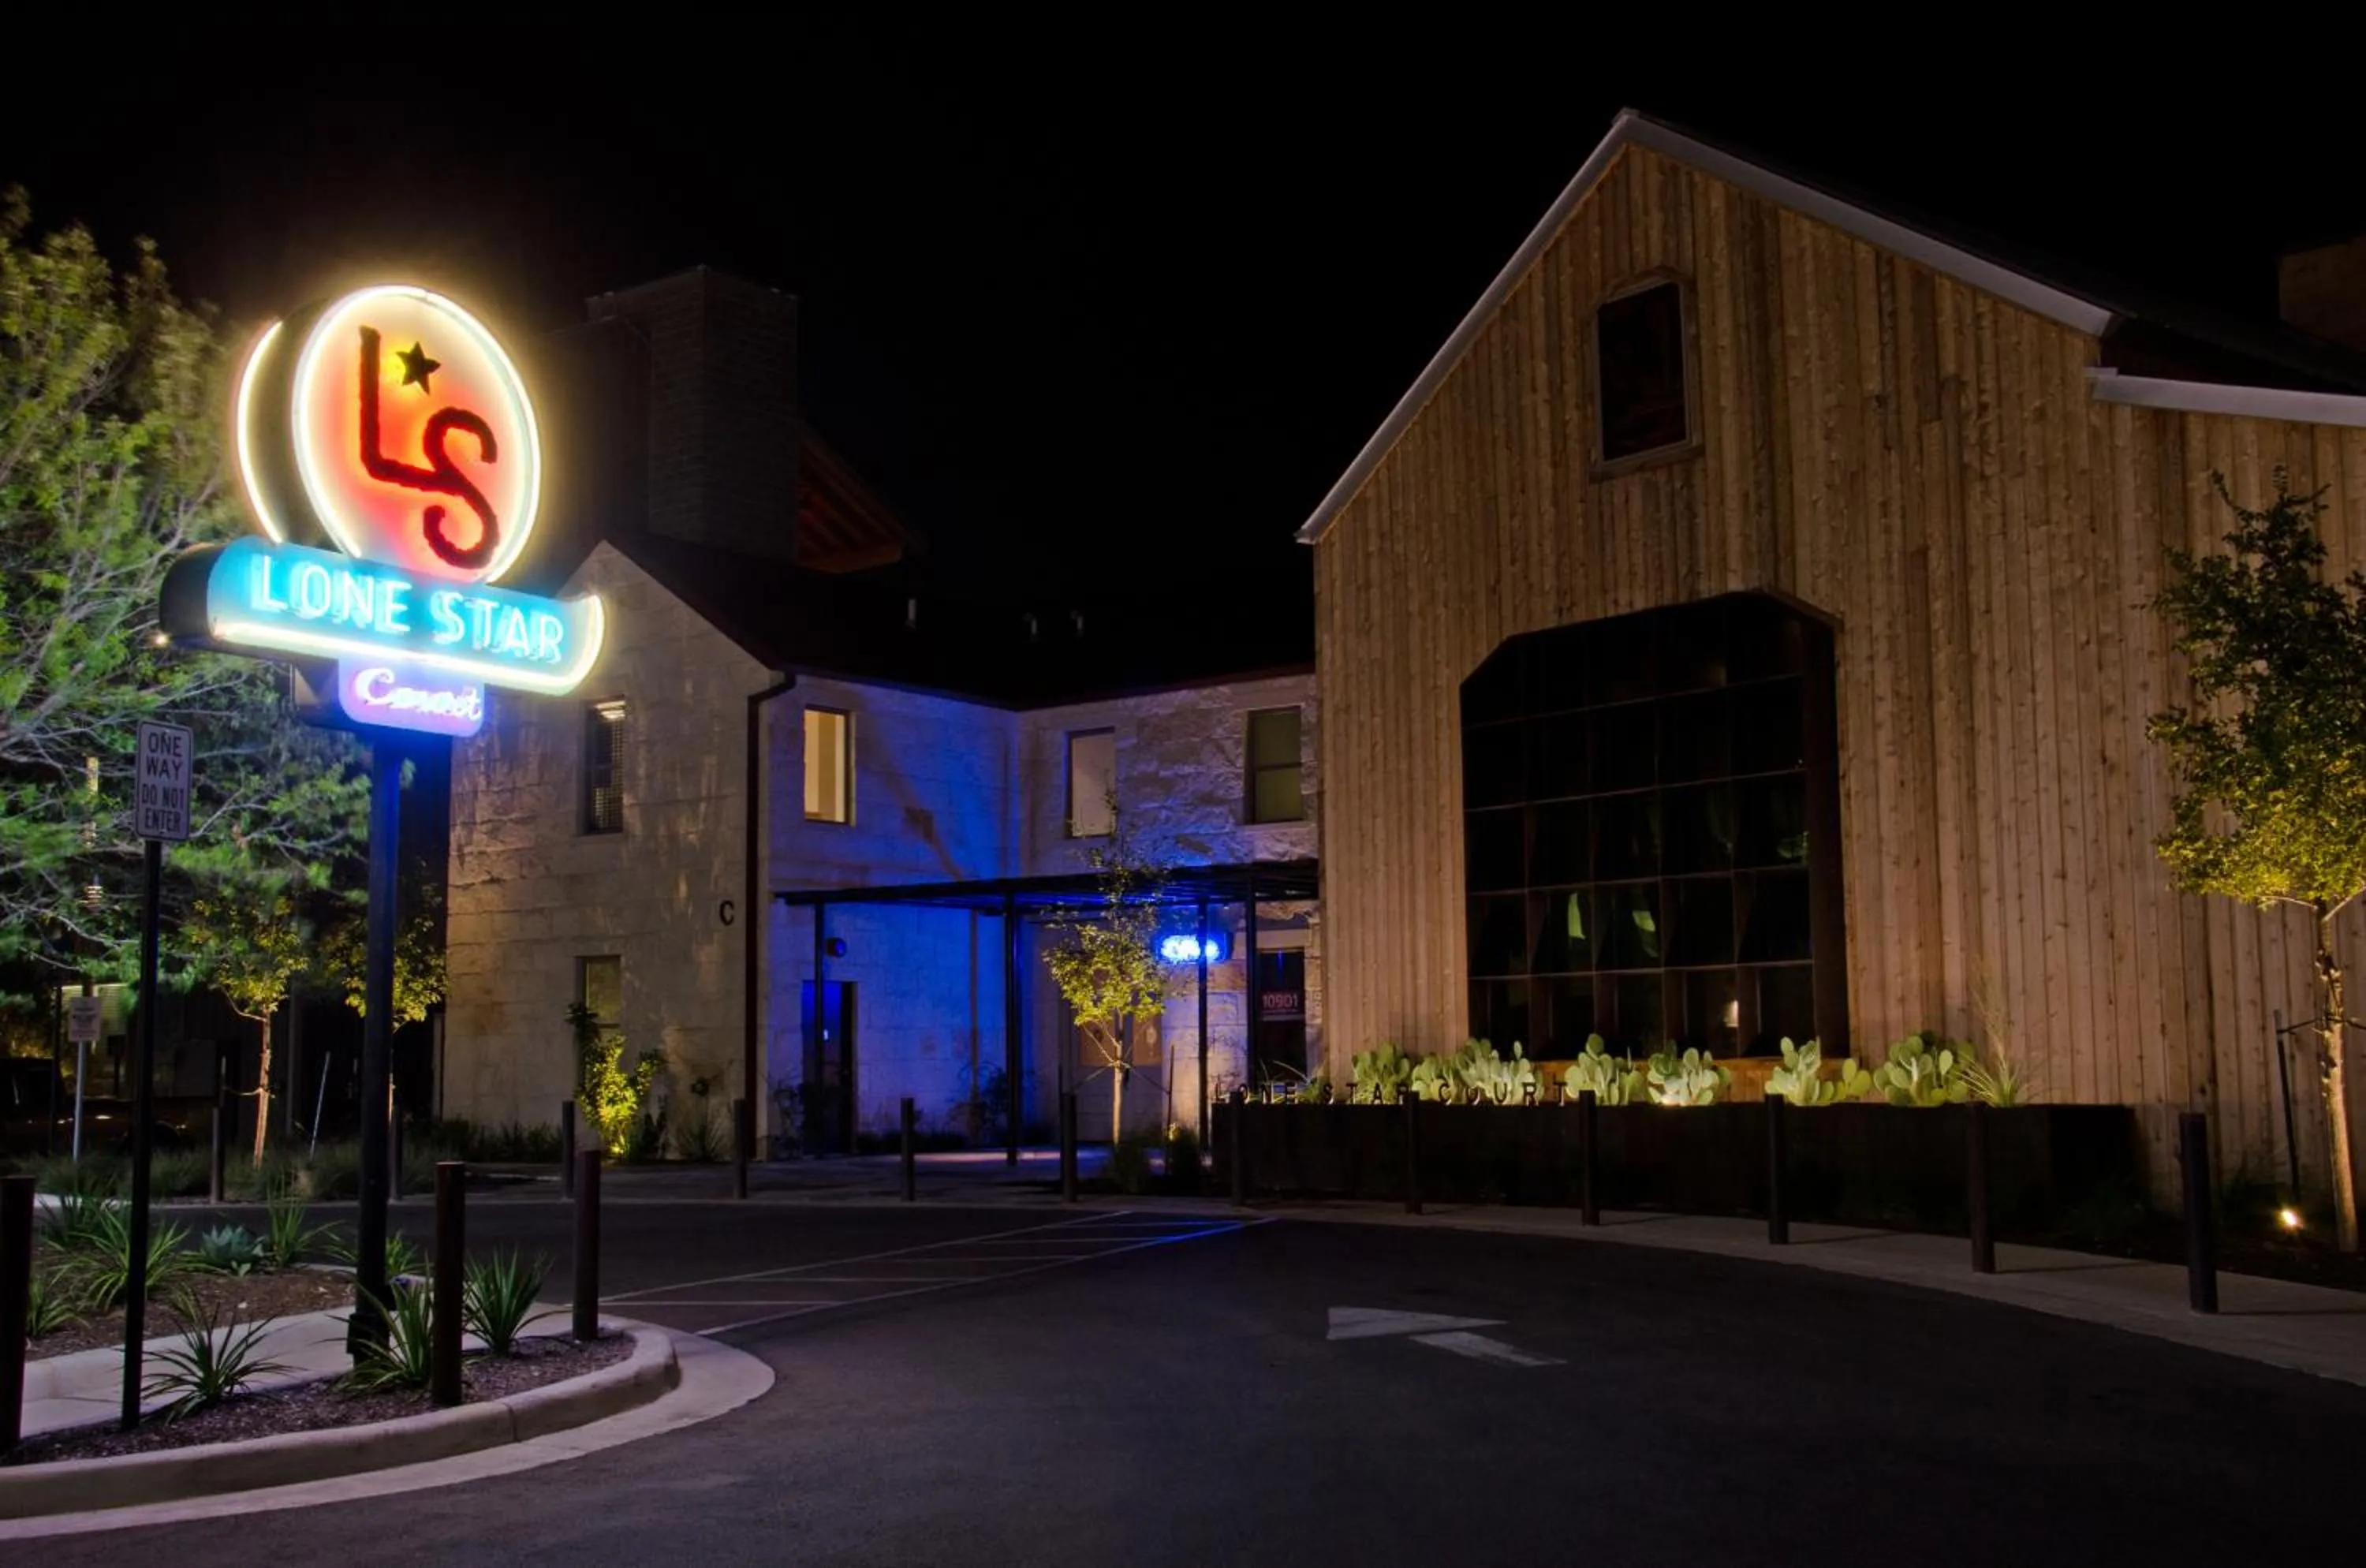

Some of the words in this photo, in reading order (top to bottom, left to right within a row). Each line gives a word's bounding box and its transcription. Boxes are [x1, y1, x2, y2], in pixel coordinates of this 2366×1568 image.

[252, 553, 412, 635] LONE
[430, 589, 565, 664] STAR
[147, 731, 183, 758] ONE
[146, 754, 184, 781] WAY
[141, 783, 158, 806] DO
[162, 786, 185, 810] NOT
[144, 807, 181, 833] ENTER
[718, 900, 734, 926] C
[1262, 992, 1299, 1009] 10901
[1215, 1082, 1297, 1104] LONE
[1323, 1082, 1409, 1105] STAR
[1439, 1081, 1568, 1106] COURT
